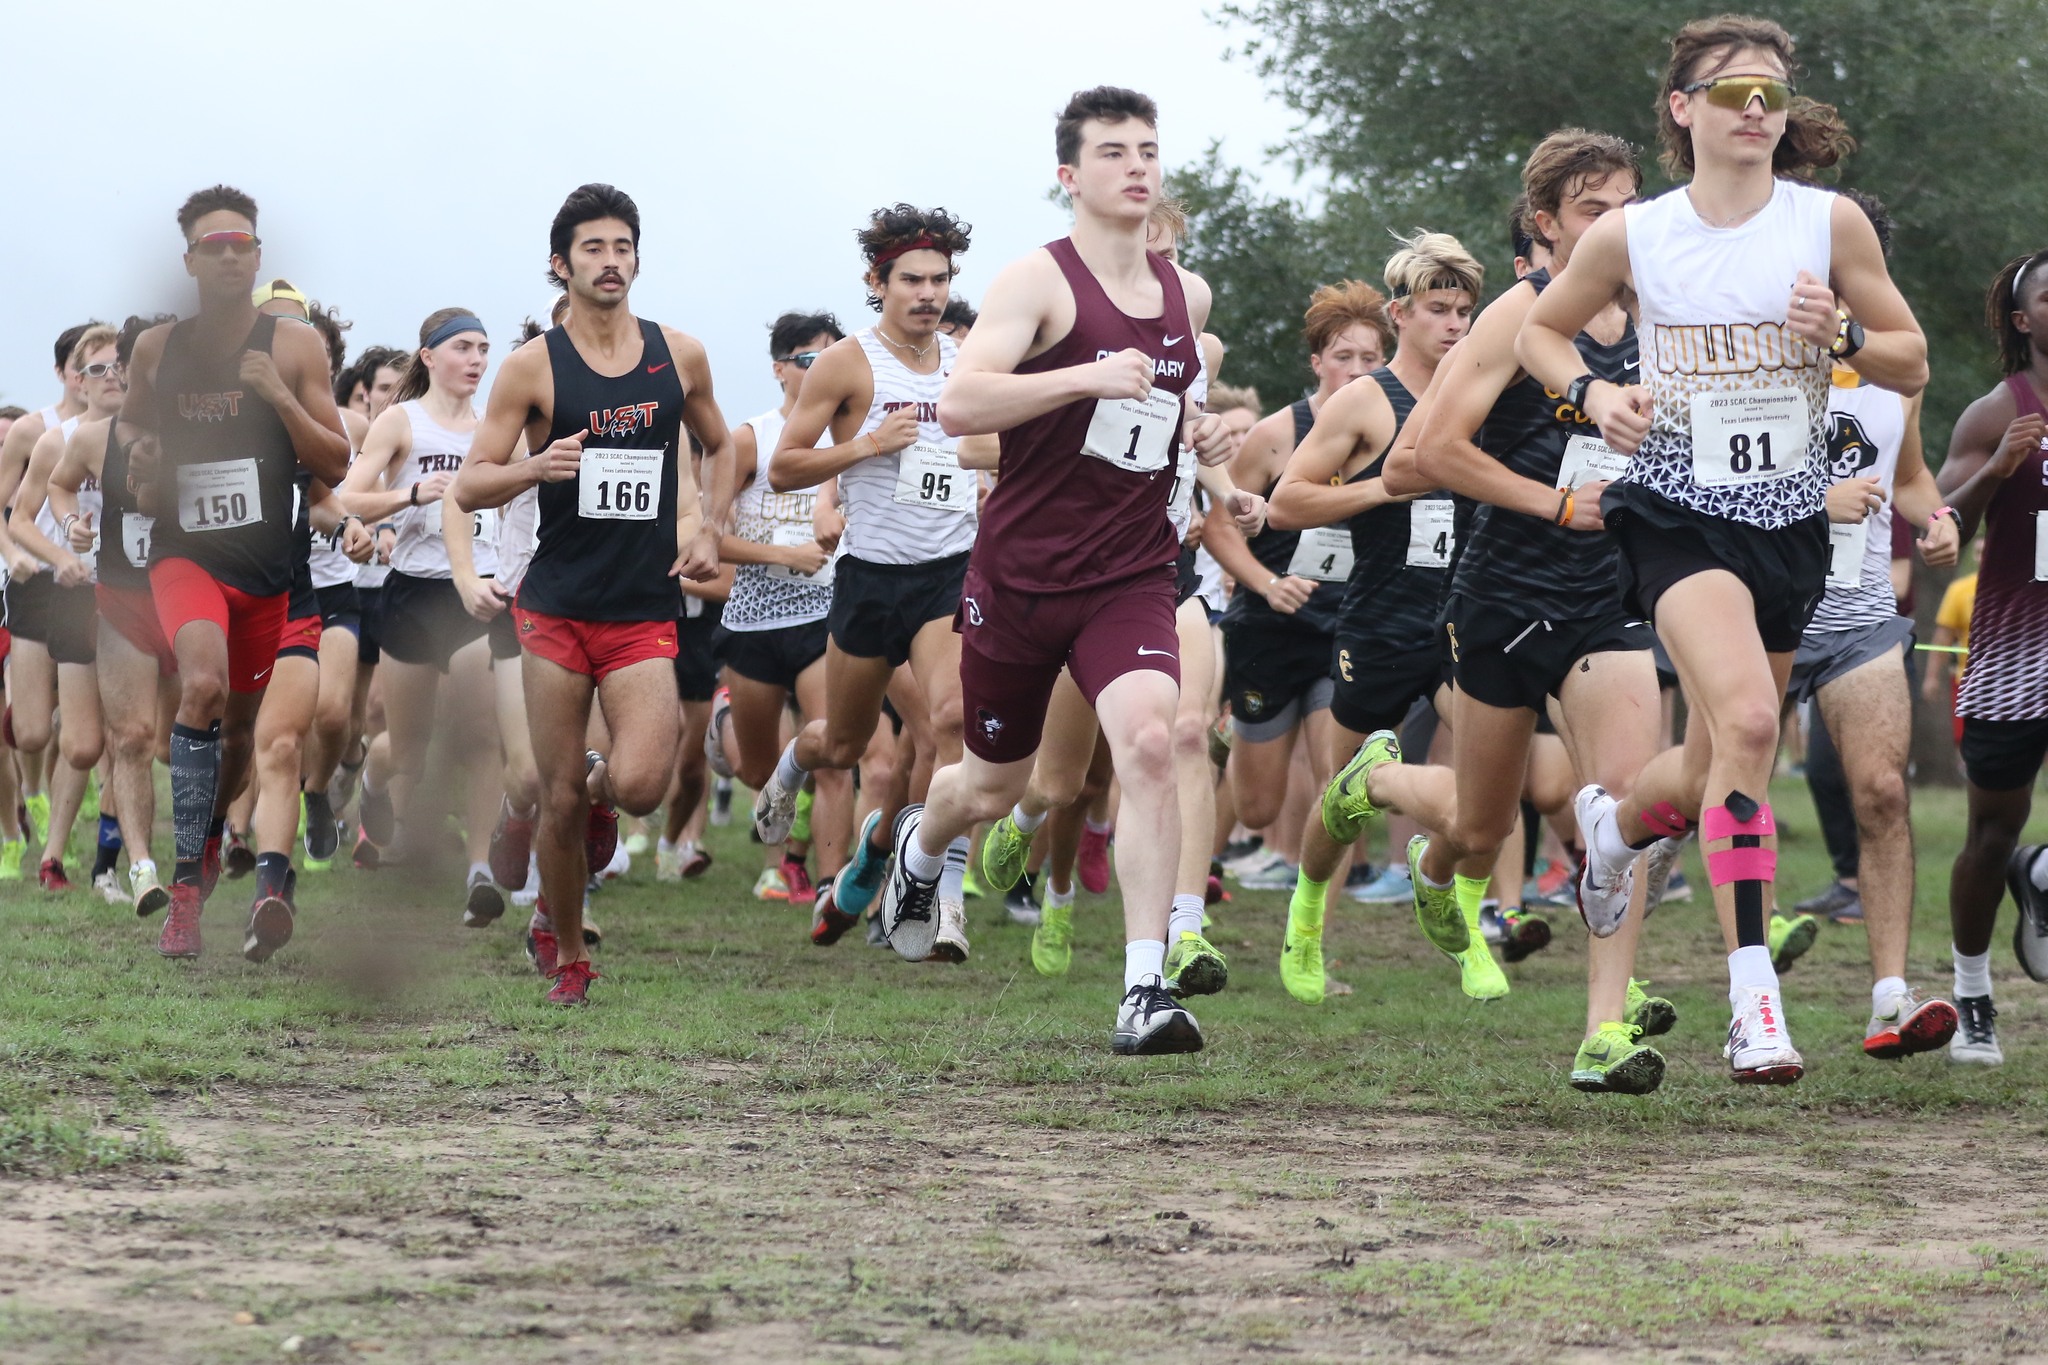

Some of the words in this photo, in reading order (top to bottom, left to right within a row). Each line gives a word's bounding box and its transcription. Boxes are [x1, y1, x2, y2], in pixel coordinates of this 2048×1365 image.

[1710, 399, 1728, 408] 2023
[1730, 398, 1747, 406] SCAC
[1749, 395, 1798, 405] Championships
[590, 401, 658, 438] UST
[1720, 417, 1737, 425] Texas
[1738, 416, 1762, 424] Lutheran
[1763, 414, 1790, 422] University
[595, 452, 609, 460] 2023
[623, 453, 658, 461] Championships
[1124, 424, 1142, 461] 1
[1581, 442, 1597, 451] 2023
[1729, 431, 1776, 474] 81
[597, 481, 650, 512] 166
[920, 472, 952, 502] 95
[194, 493, 247, 526] 150
[1319, 553, 1336, 575] 4
